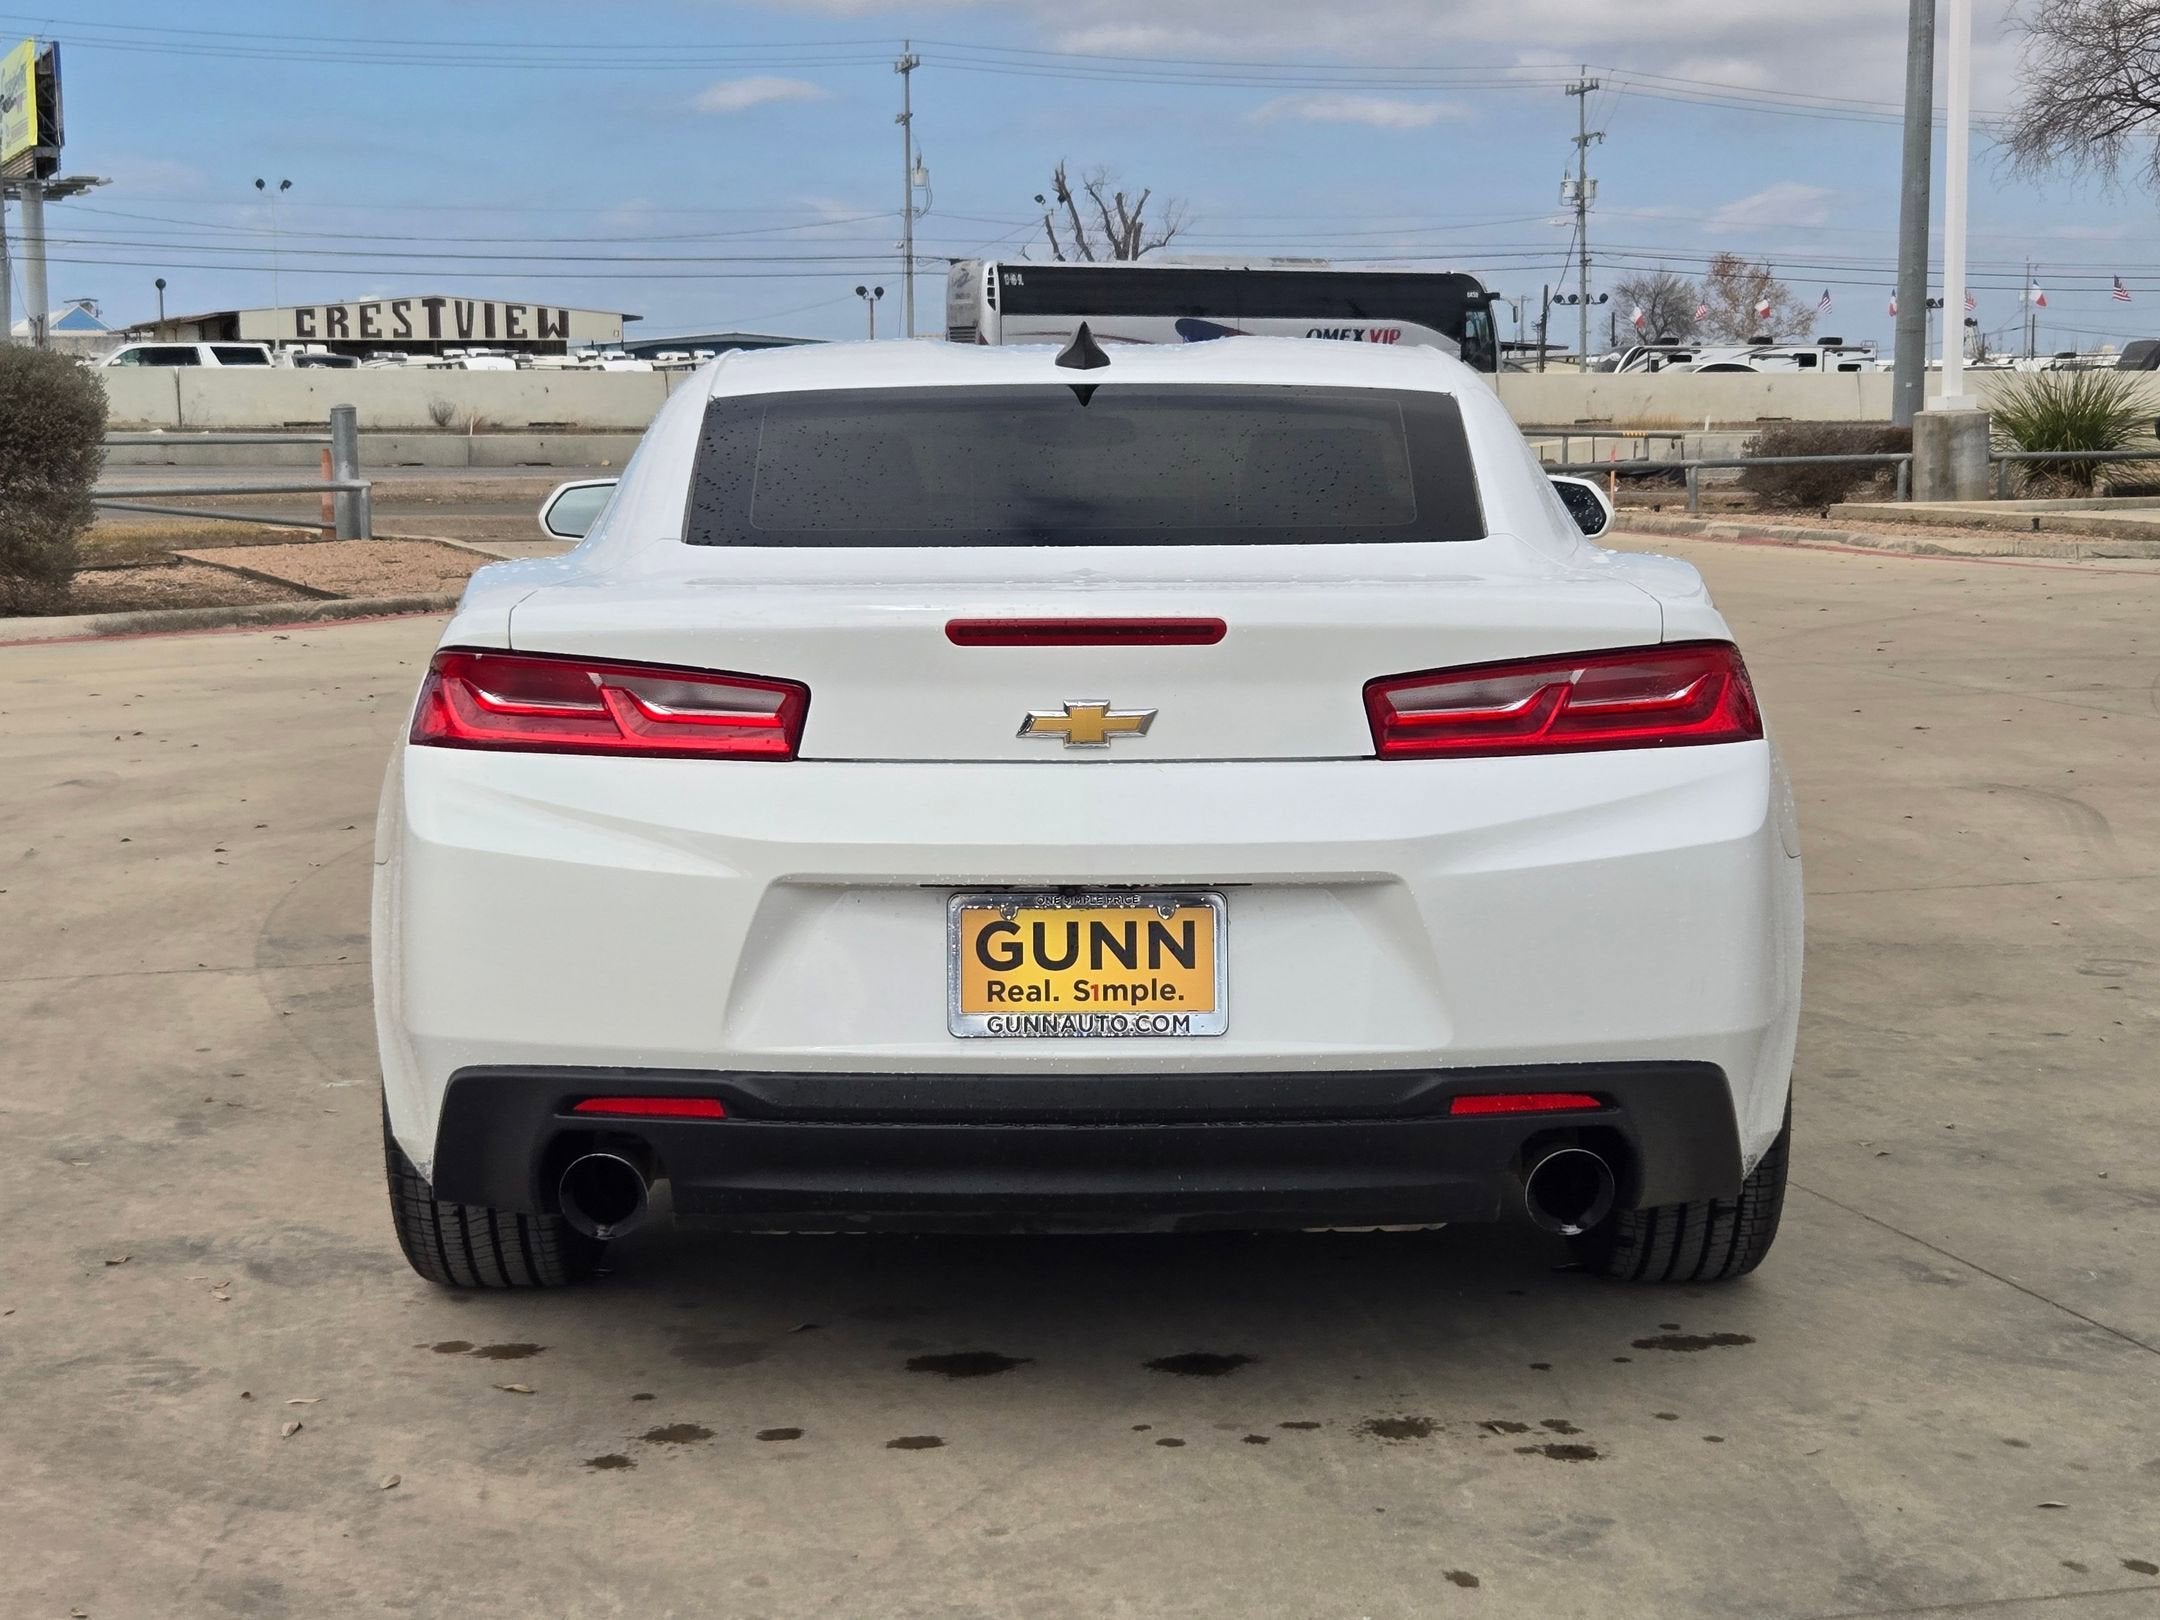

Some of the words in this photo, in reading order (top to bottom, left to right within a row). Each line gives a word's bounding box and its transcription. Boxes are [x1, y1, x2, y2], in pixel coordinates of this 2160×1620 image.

[295, 298, 569, 338] CRESTVIEW
[1369, 328, 1401, 344] VIP
[1036, 895, 1060, 906] ONE
[1063, 895, 1104, 906] SIMPLE
[1106, 895, 1140, 905] PRICE
[975, 920, 1196, 971] GUNN
[987, 979, 1059, 1002] Real.
[987, 1015, 1190, 1034] GUNNAUTO.COM
